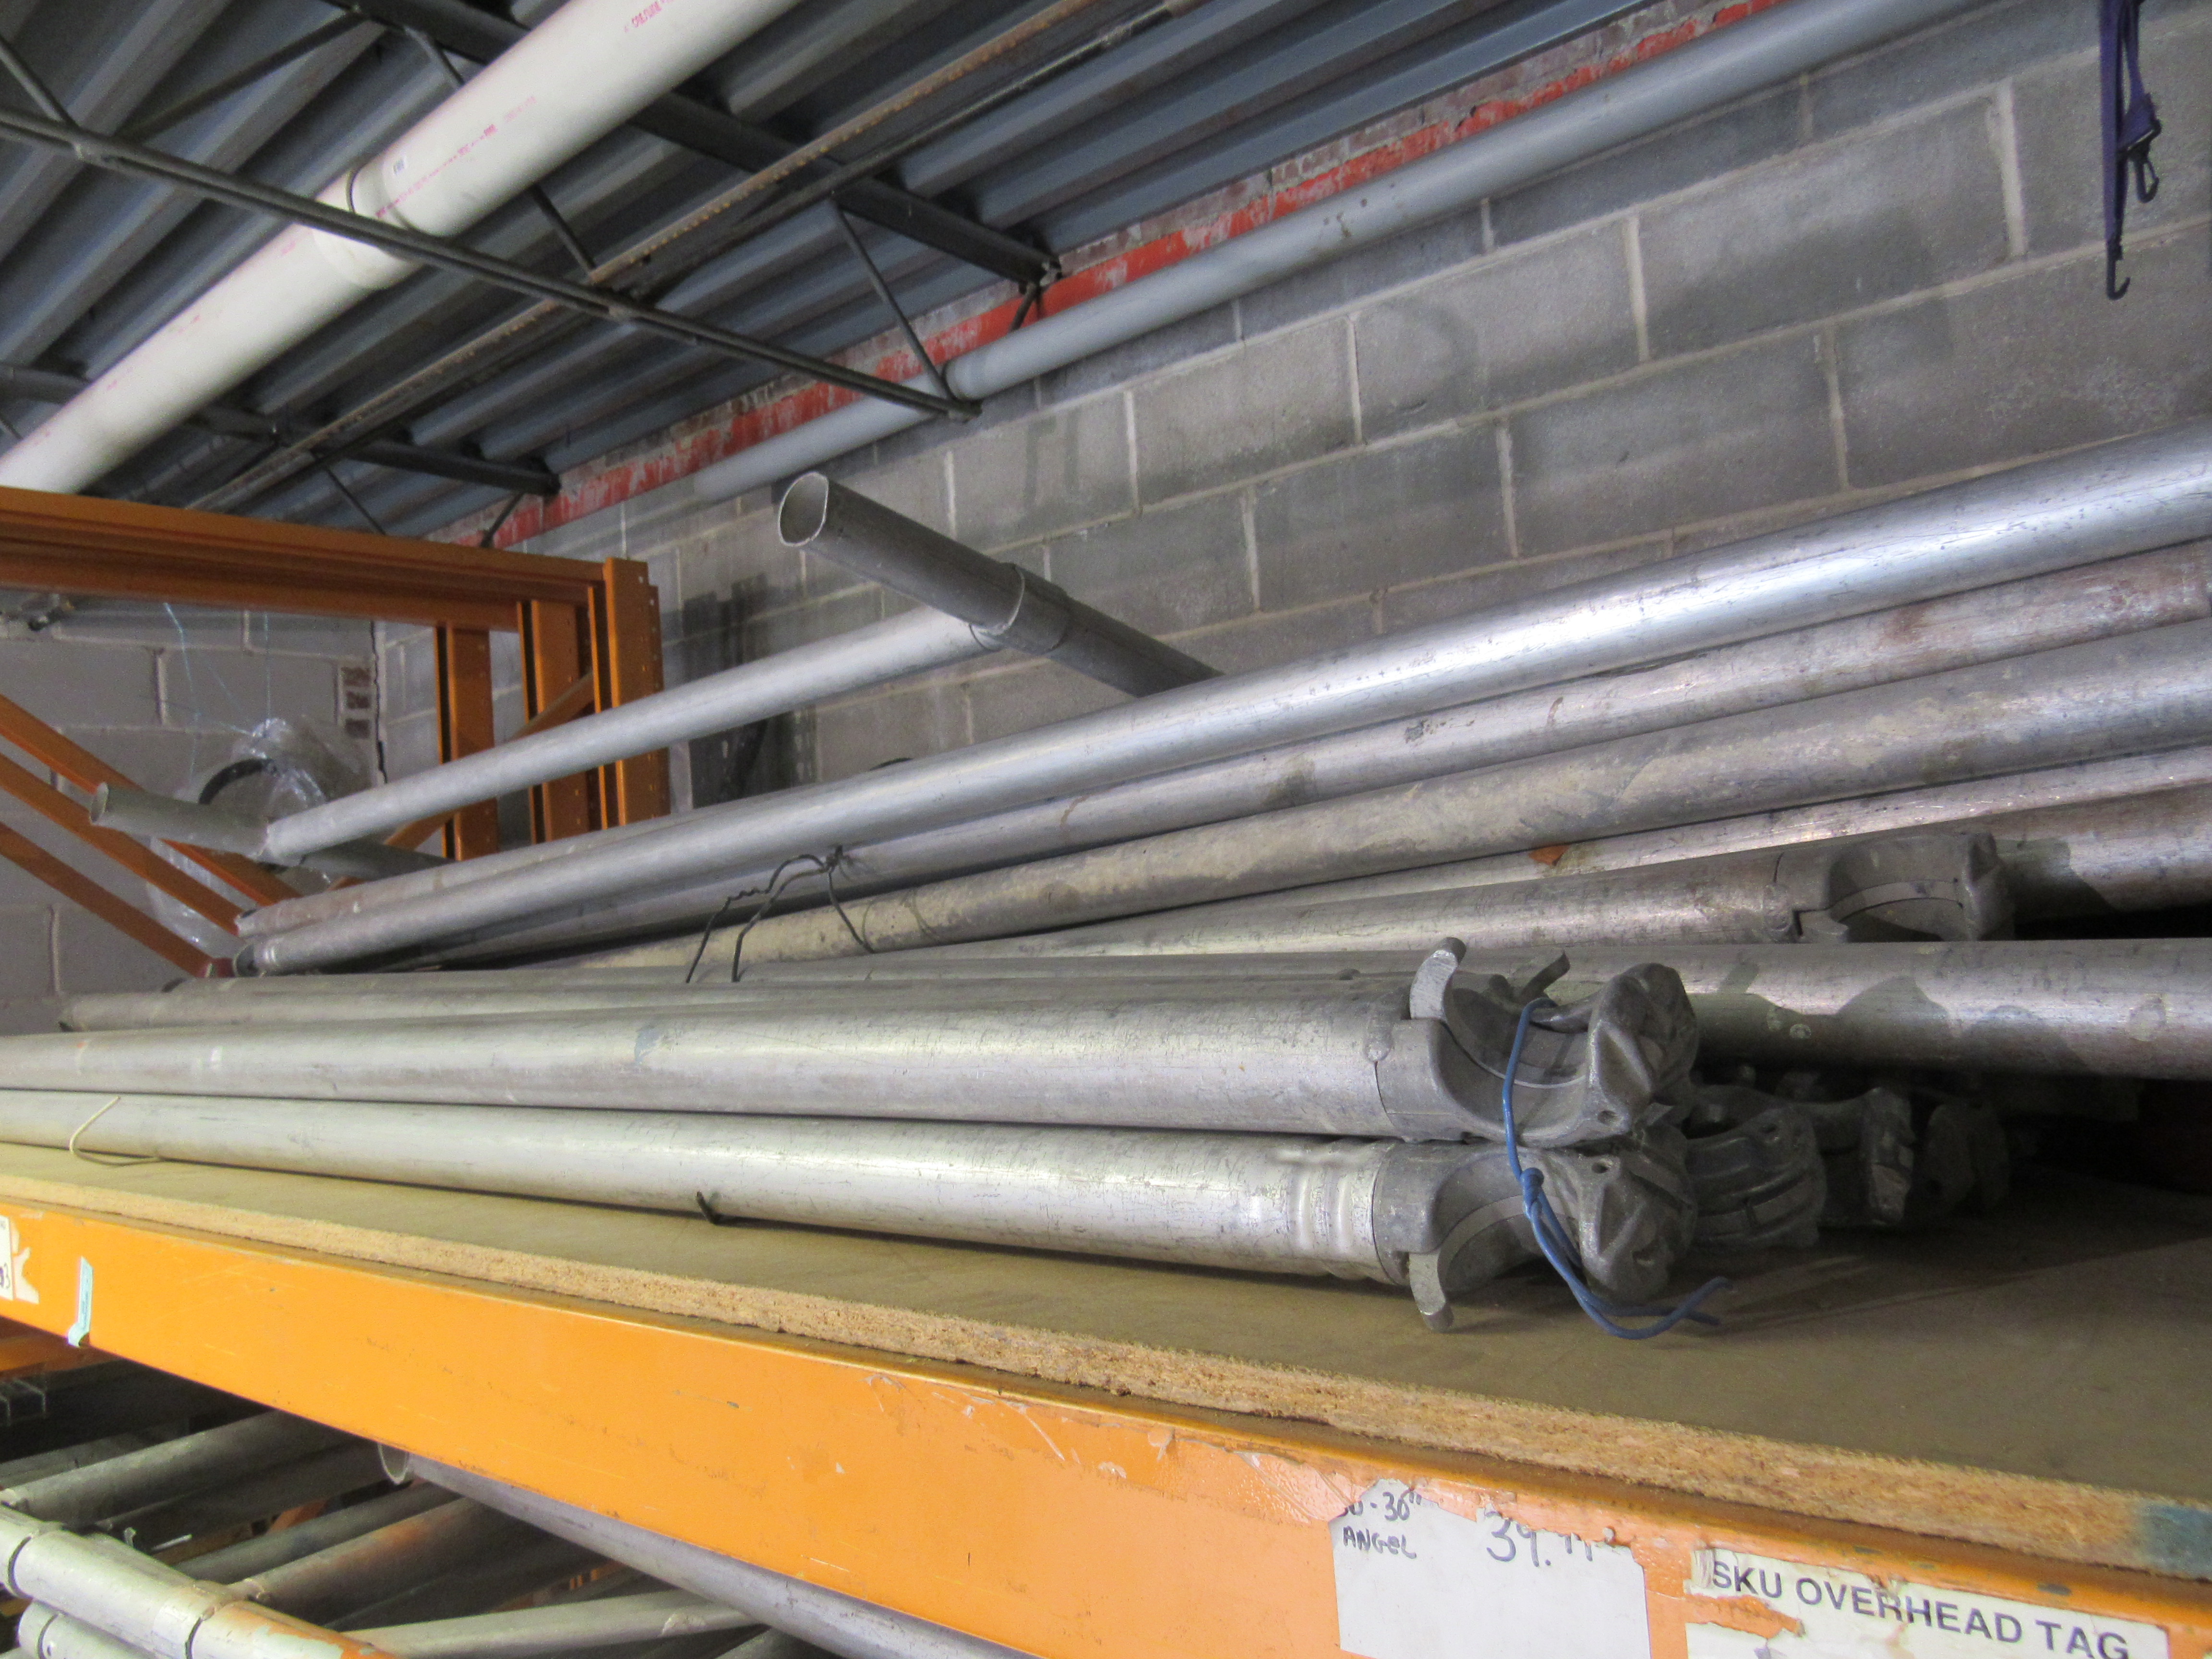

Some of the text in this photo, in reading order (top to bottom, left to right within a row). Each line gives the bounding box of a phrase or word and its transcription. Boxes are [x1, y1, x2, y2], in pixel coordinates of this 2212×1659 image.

[1712, 1560, 2129, 1659] SKU OVERHEAD TAG
